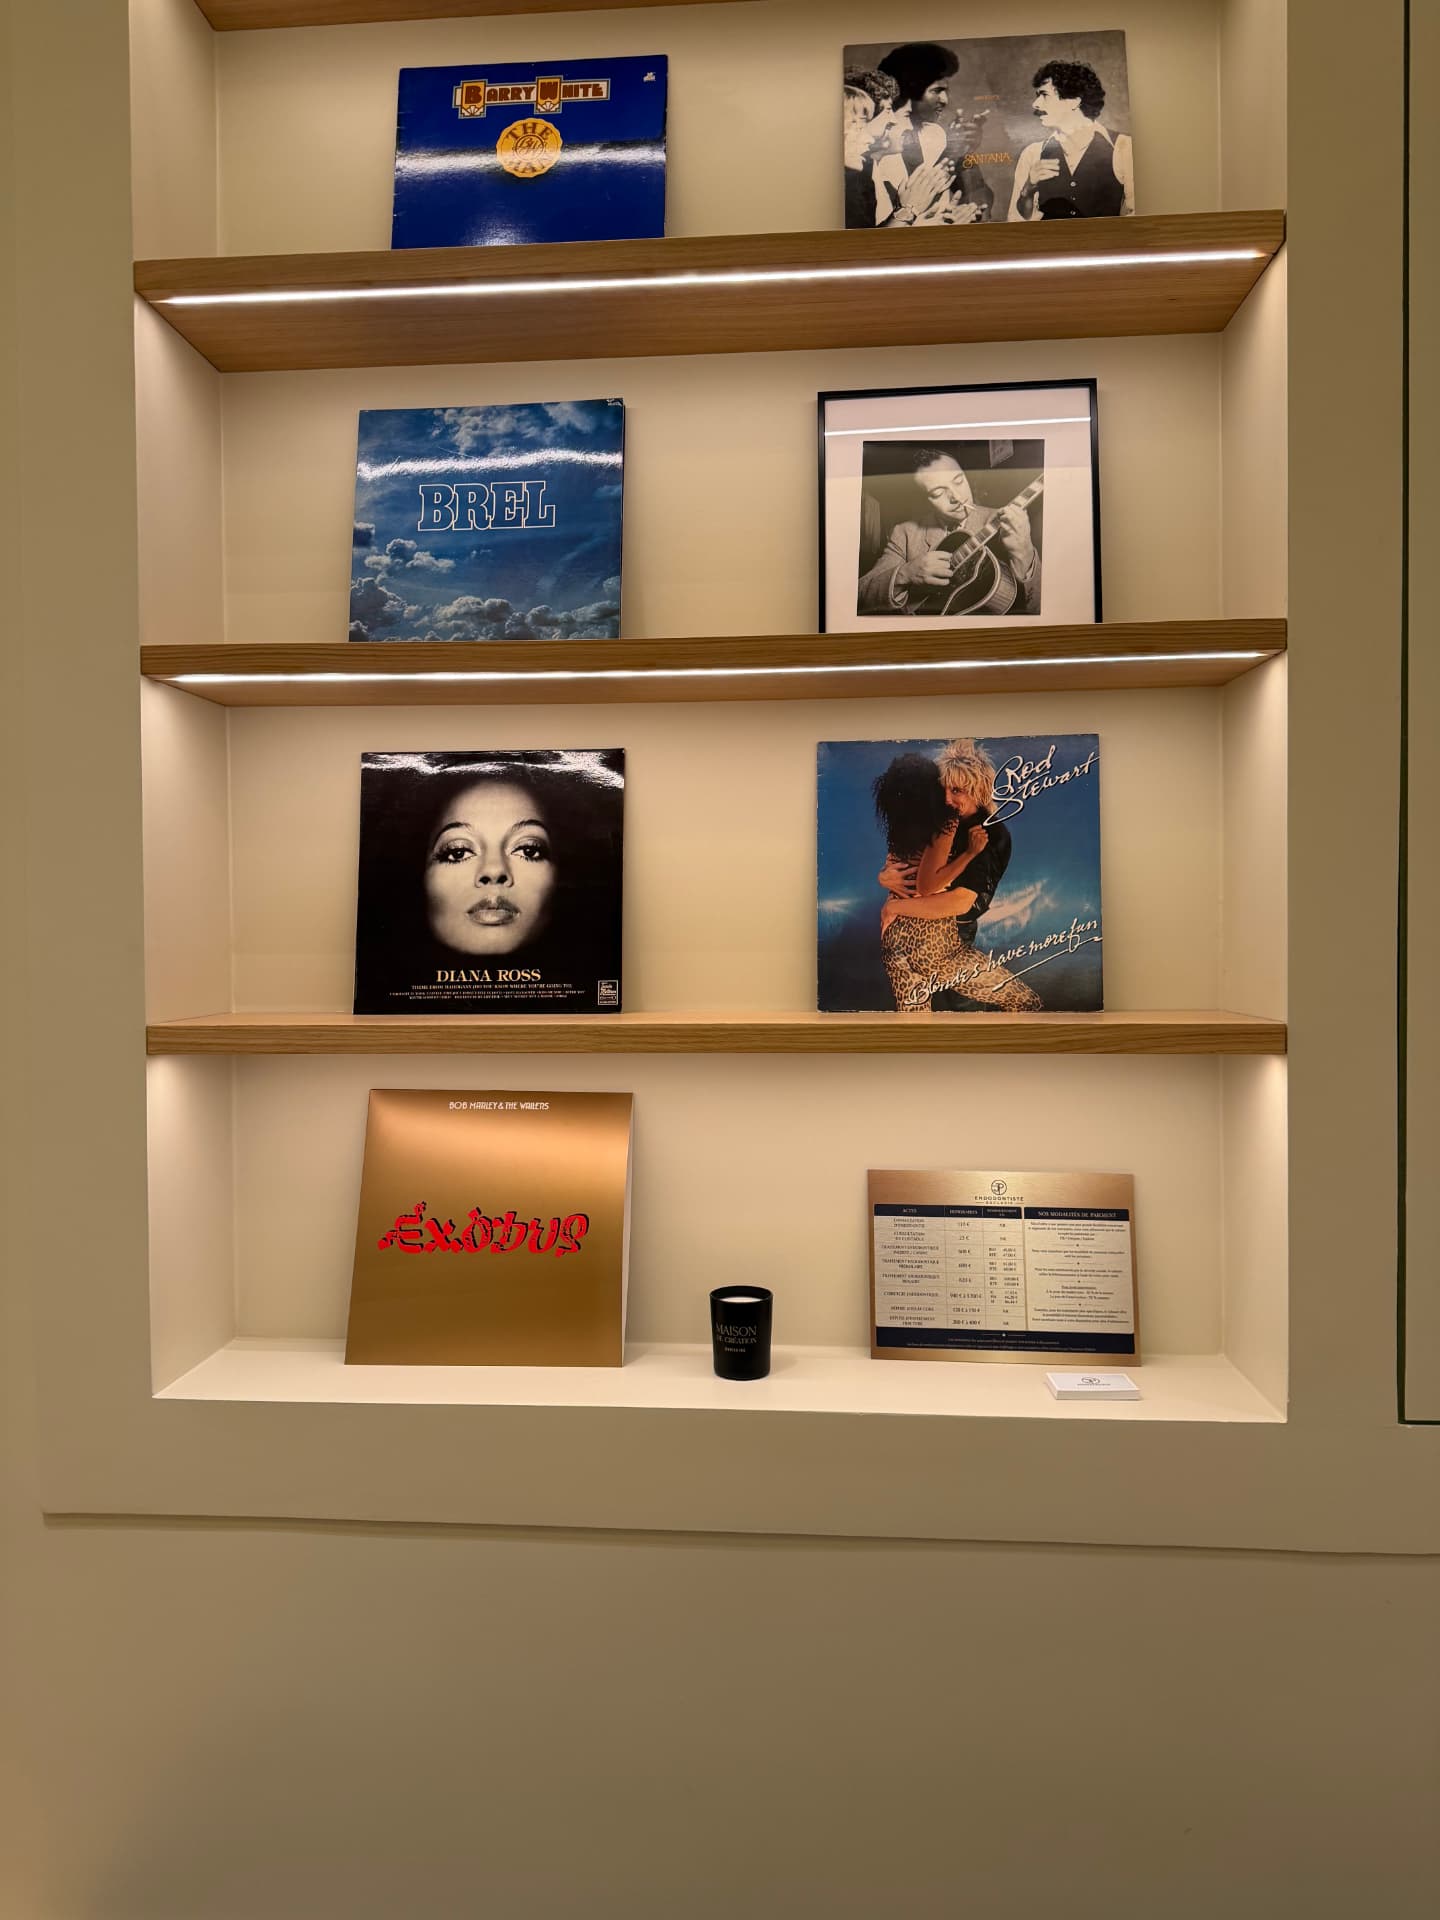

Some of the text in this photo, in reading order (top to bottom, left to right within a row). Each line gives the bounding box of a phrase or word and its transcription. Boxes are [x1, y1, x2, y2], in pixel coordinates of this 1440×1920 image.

[464, 82, 604, 104] BARRY WHITE
[505, 122, 554, 140] THE
[962, 152, 1013, 169] SANTANA
[418, 480, 555, 531] BREL
[992, 744, 1056, 793] Rod
[983, 752, 1100, 827] Stewart
[904, 917, 1098, 1005] Blondes have more fun
[437, 969, 542, 982] DIANA ROSS
[449, 1102, 467, 1110] BOB
[470, 1102, 497, 1110] MARLEY
[505, 1102, 517, 1110] THE
